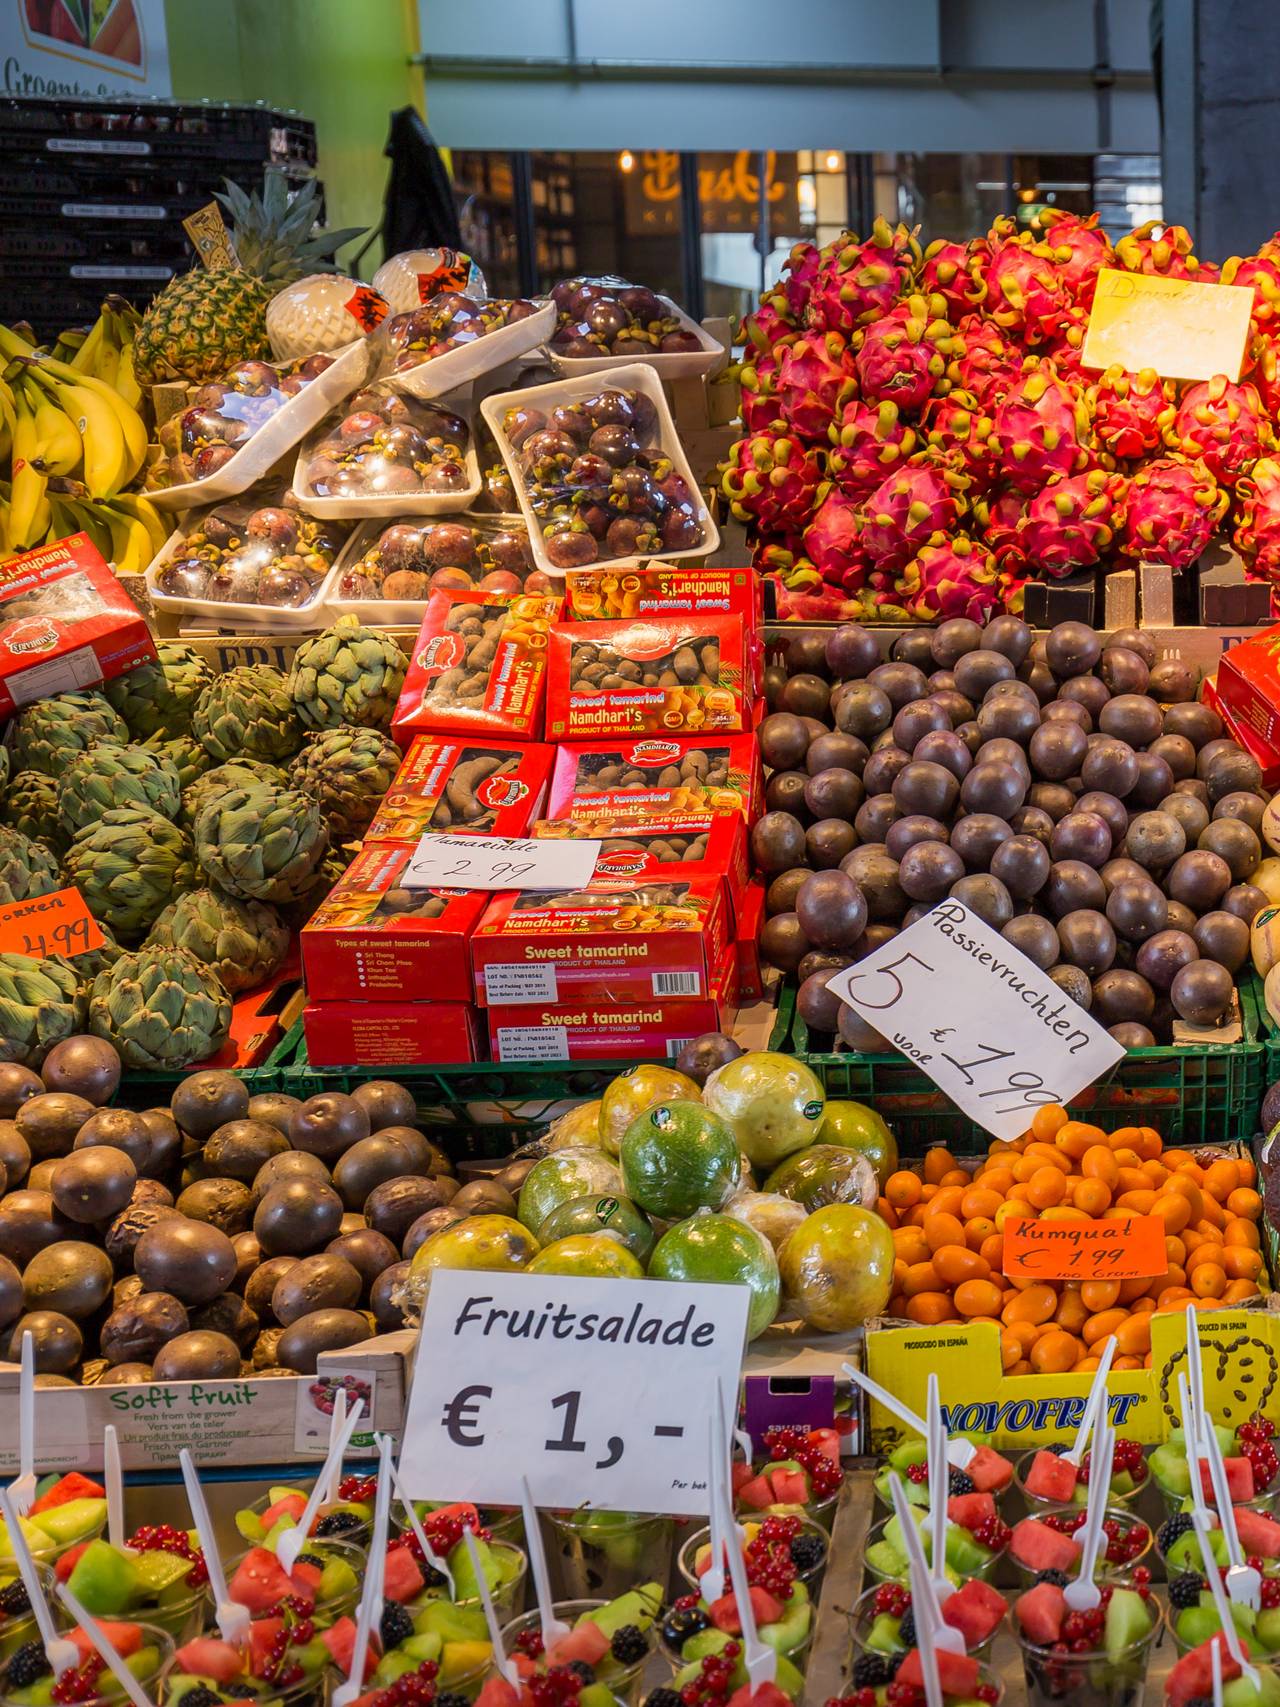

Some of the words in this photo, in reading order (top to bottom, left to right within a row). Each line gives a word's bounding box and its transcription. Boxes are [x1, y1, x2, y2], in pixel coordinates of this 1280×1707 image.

[661, 581, 730, 596] Namdhari's
[639, 599, 692, 612] tamarind
[695, 598, 730, 611] Sweet
[489, 684, 507, 712] Sweet
[501, 642, 518, 683] tamarind
[505, 660, 533, 714] Namdhari's
[569, 697, 609, 708] Sweet
[610, 692, 665, 706] tamarind
[569, 708, 642, 725] Namdhari's
[569, 727, 601, 735] PRODUCT
[572, 796, 610, 807] Sweet
[613, 791, 671, 804] tamarind
[571, 806, 646, 819] Namdhari's
[412, 860, 438, 874] €
[443, 860, 536, 883] 2.99
[504, 918, 590, 928] Namdhari's
[22, 917, 90, 960] 4.99
[336, 939, 358, 948] Types
[394, 939, 430, 947] tamarind
[525, 945, 572, 960] Sweet
[576, 943, 649, 958] tamarind
[848, 952, 934, 1010] 5
[931, 902, 1091, 1054] Passievruchten
[541, 1013, 588, 1026] Sweet
[592, 1010, 663, 1025] tamarind
[1015, 1218, 1133, 1246] Kumquat
[1012, 1248, 1050, 1269] €
[454, 1296, 716, 1348] Fruitsalade
[1220, 1322, 1228, 1331] IN
[1229, 1322, 1247, 1331] SPAIN
[904, 1339, 937, 1351] PRODUCIDO
[938, 1339, 947, 1348] EN
[110, 1386, 178, 1410] Soft
[188, 1384, 258, 1407] fruit
[134, 1411, 160, 1422] Fresh
[161, 1411, 185, 1421] from
[186, 1410, 201, 1420] the
[203, 1410, 238, 1421] grower
[441, 1385, 493, 1447] €
[147, 1422, 169, 1432] Vers
[171, 1422, 187, 1430] van
[189, 1421, 201, 1430] de
[204, 1420, 227, 1430] teler
[138, 1432, 170, 1444] produit
[204, 1429, 251, 1441] producteur
[143, 1441, 172, 1452] Frisch
[671, 1479, 688, 1490] Per
